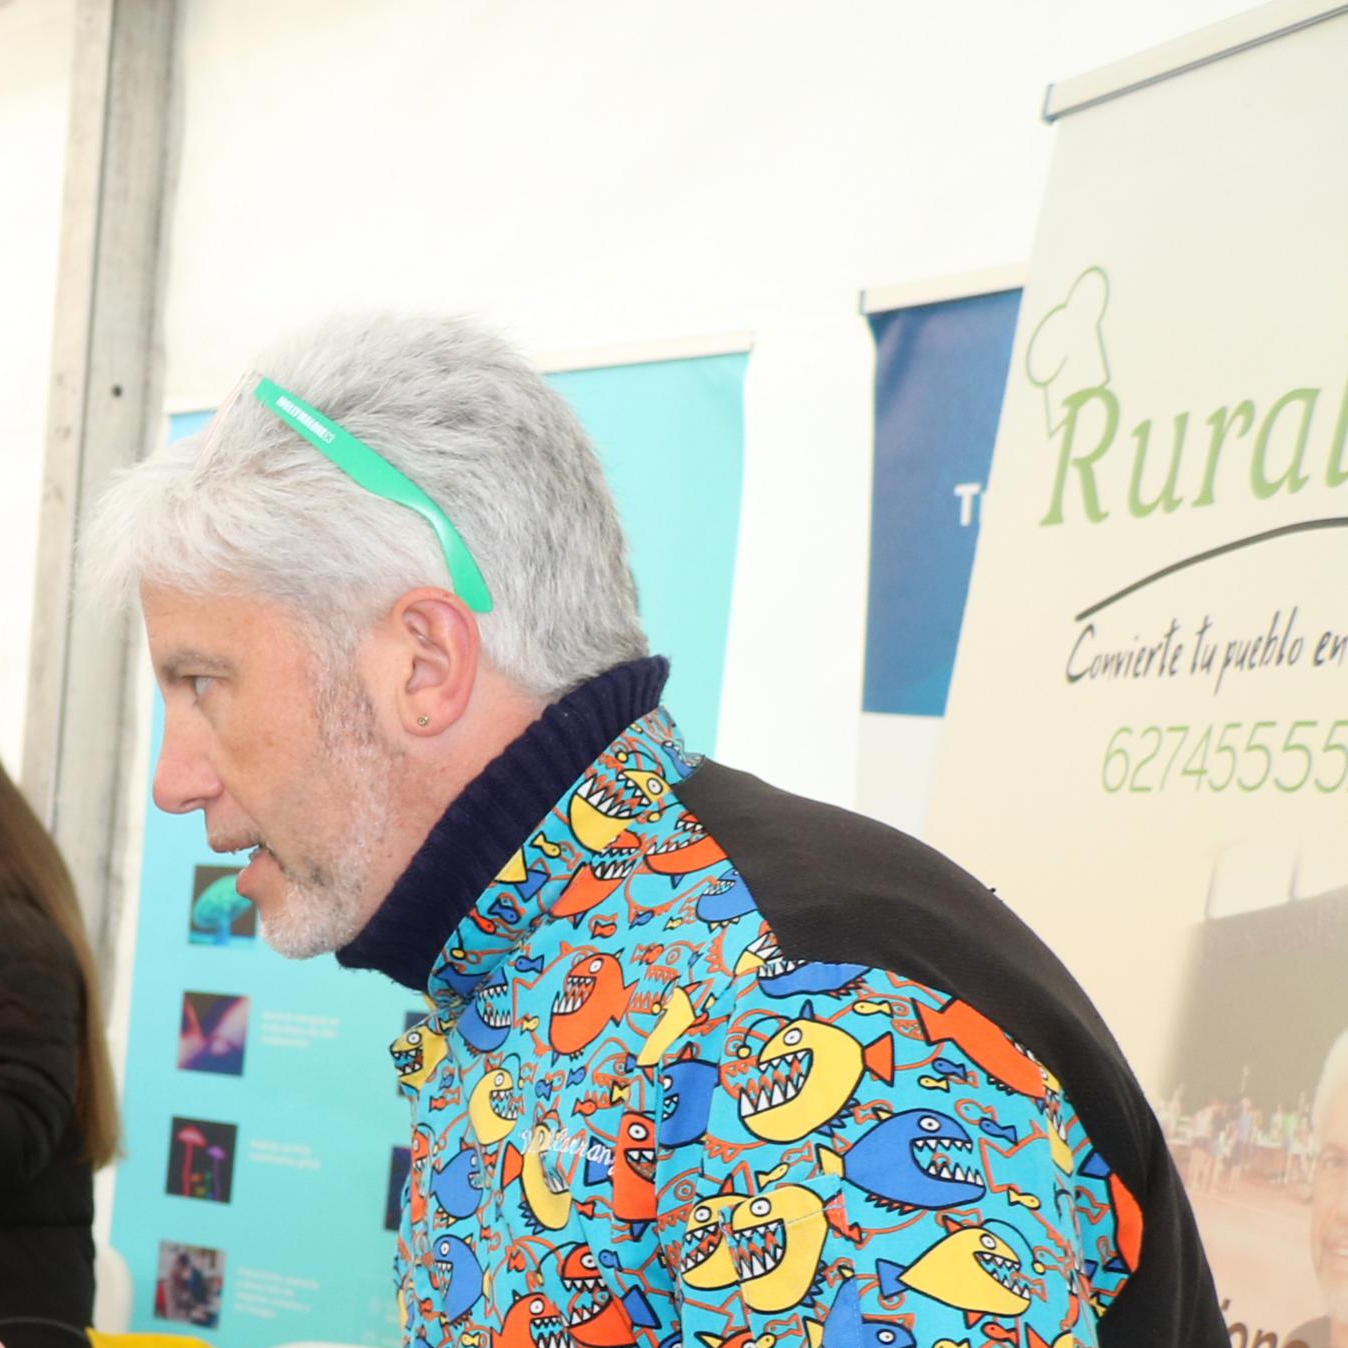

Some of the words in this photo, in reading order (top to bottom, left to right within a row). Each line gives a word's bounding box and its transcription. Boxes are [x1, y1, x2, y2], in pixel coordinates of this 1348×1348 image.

[1065, 617, 1183, 684] Convierte
[1190, 614, 1219, 676] tu
[1213, 605, 1304, 697] pueblo
